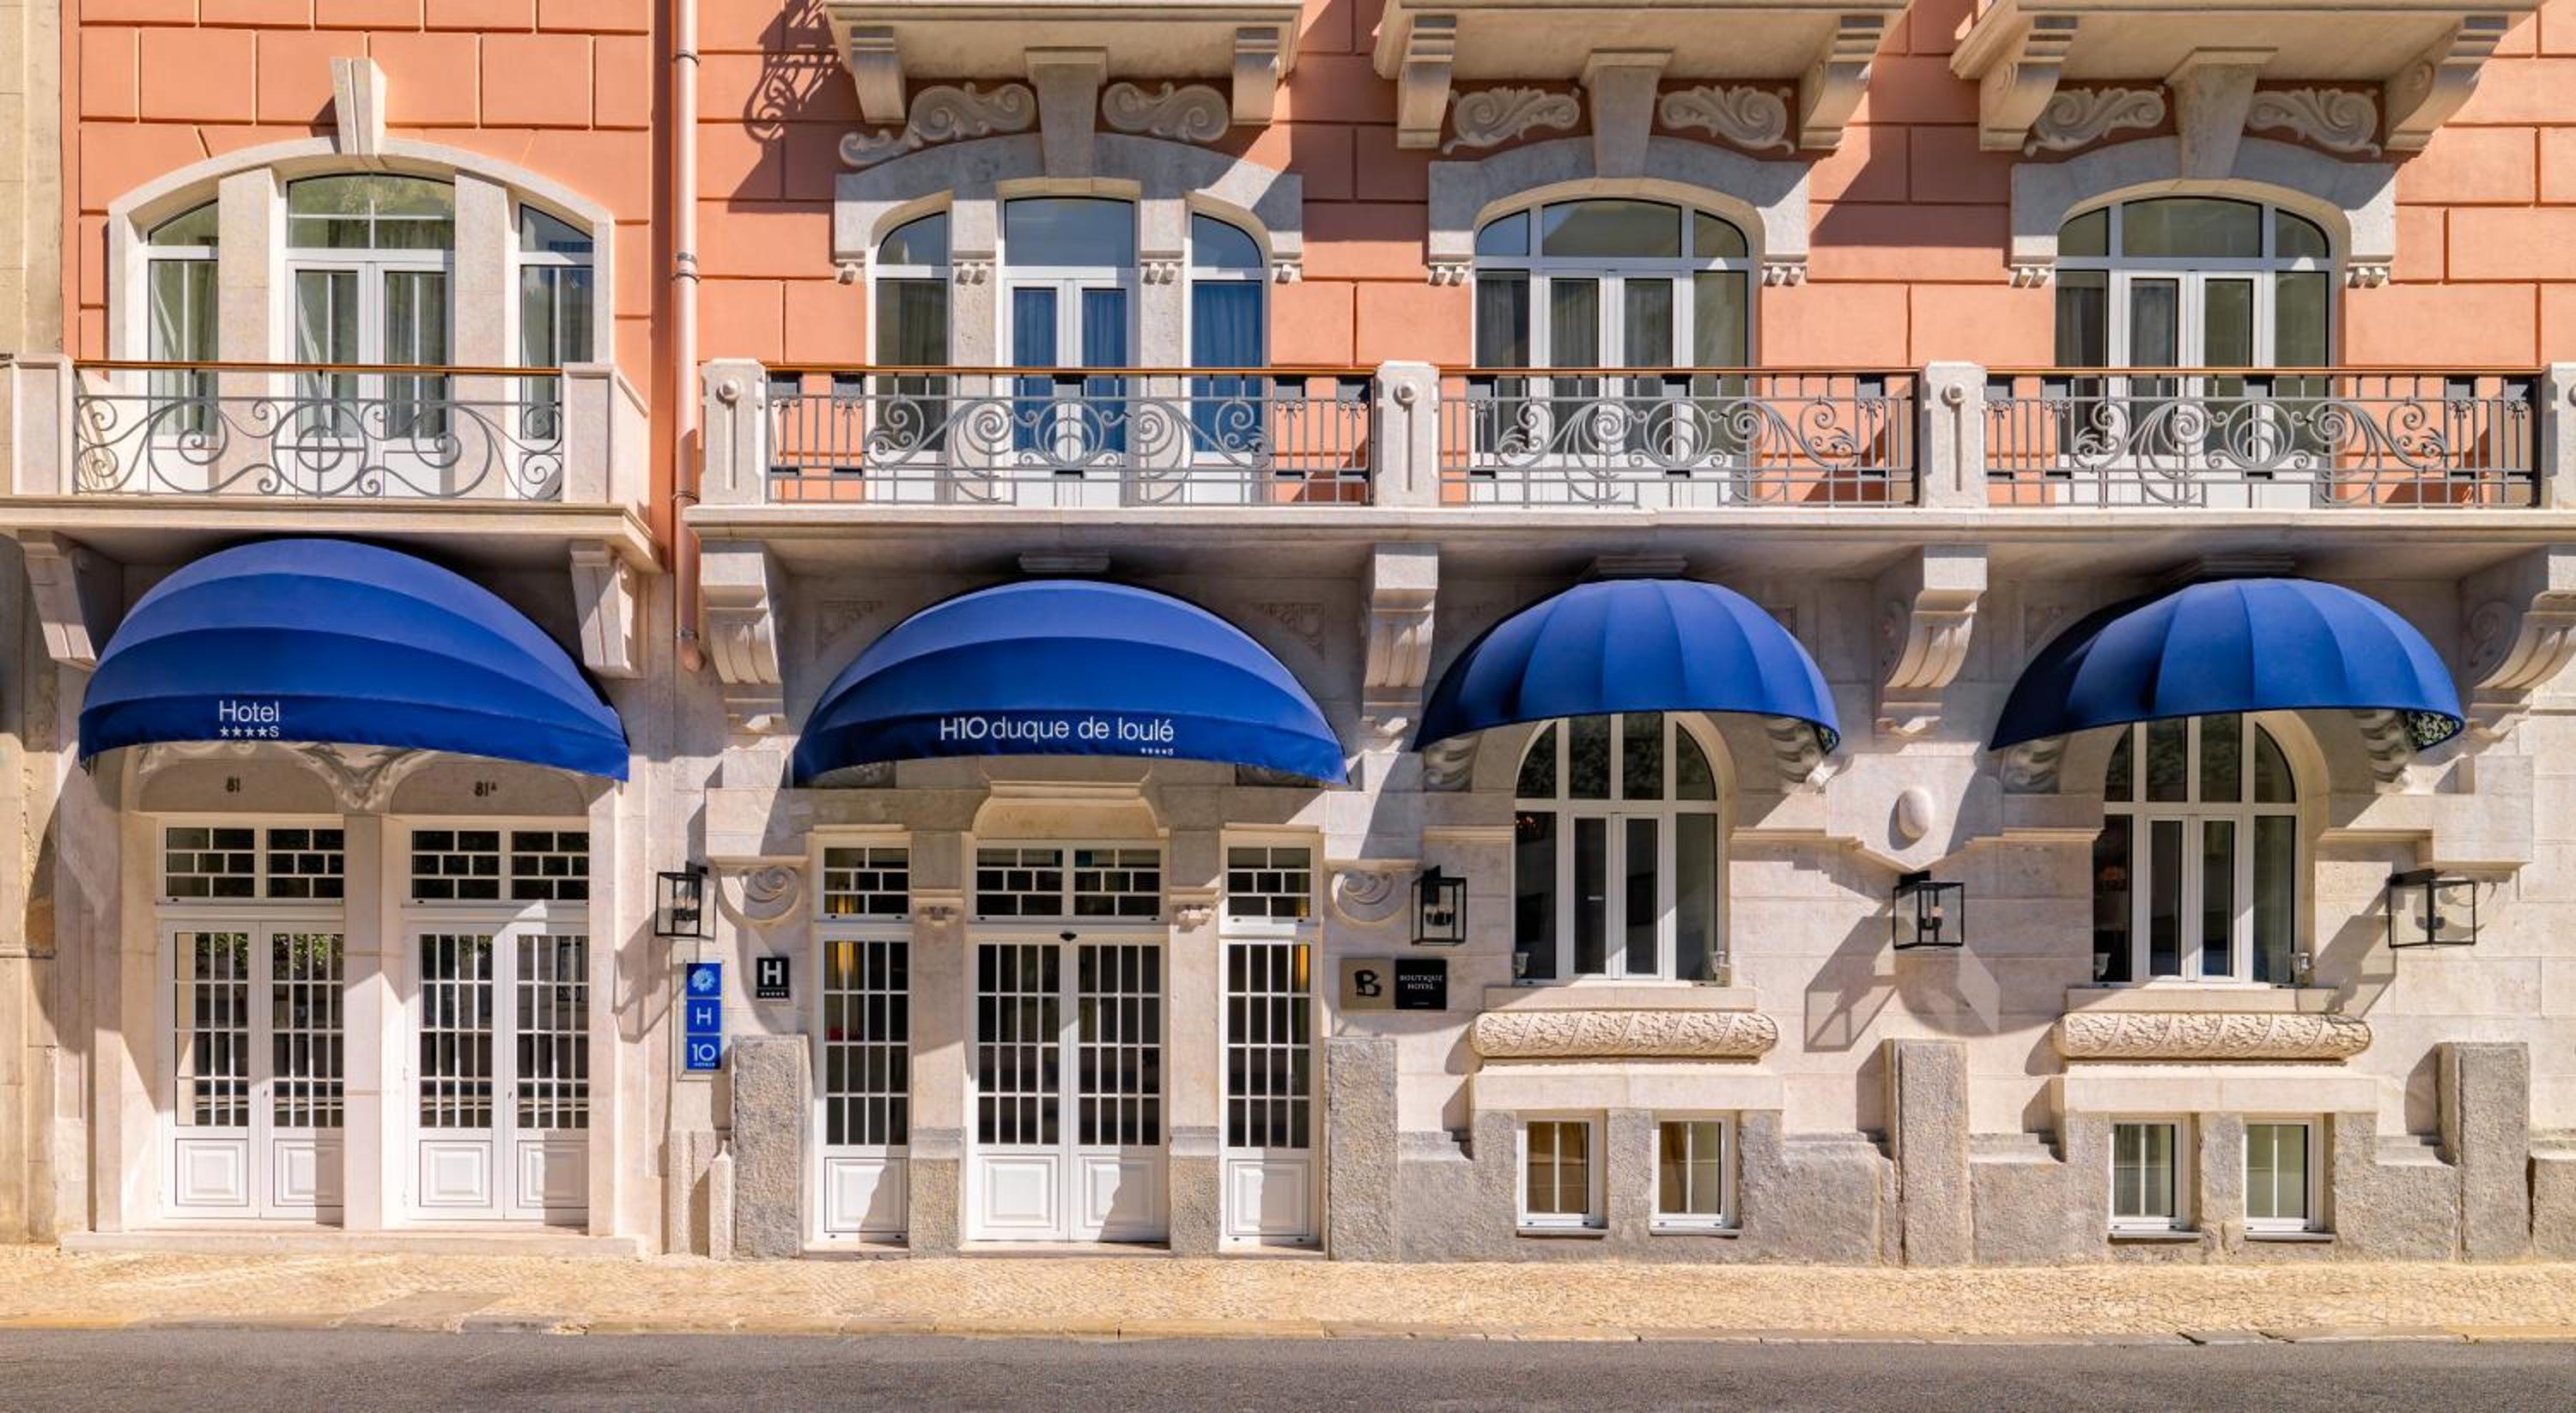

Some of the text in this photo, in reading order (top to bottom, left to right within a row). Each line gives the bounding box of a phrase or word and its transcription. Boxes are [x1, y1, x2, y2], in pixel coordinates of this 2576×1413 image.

[219, 700, 279, 723] Hotel
[990, 715, 1070, 743] duque
[1078, 716, 1109, 739] de
[1118, 717, 1174, 743] loulé
[226, 776, 240, 792] 81
[762, 961, 782, 986] H
[1354, 969, 1382, 998] B
[696, 1006, 713, 1026] H
[691, 1042, 716, 1062] 10
